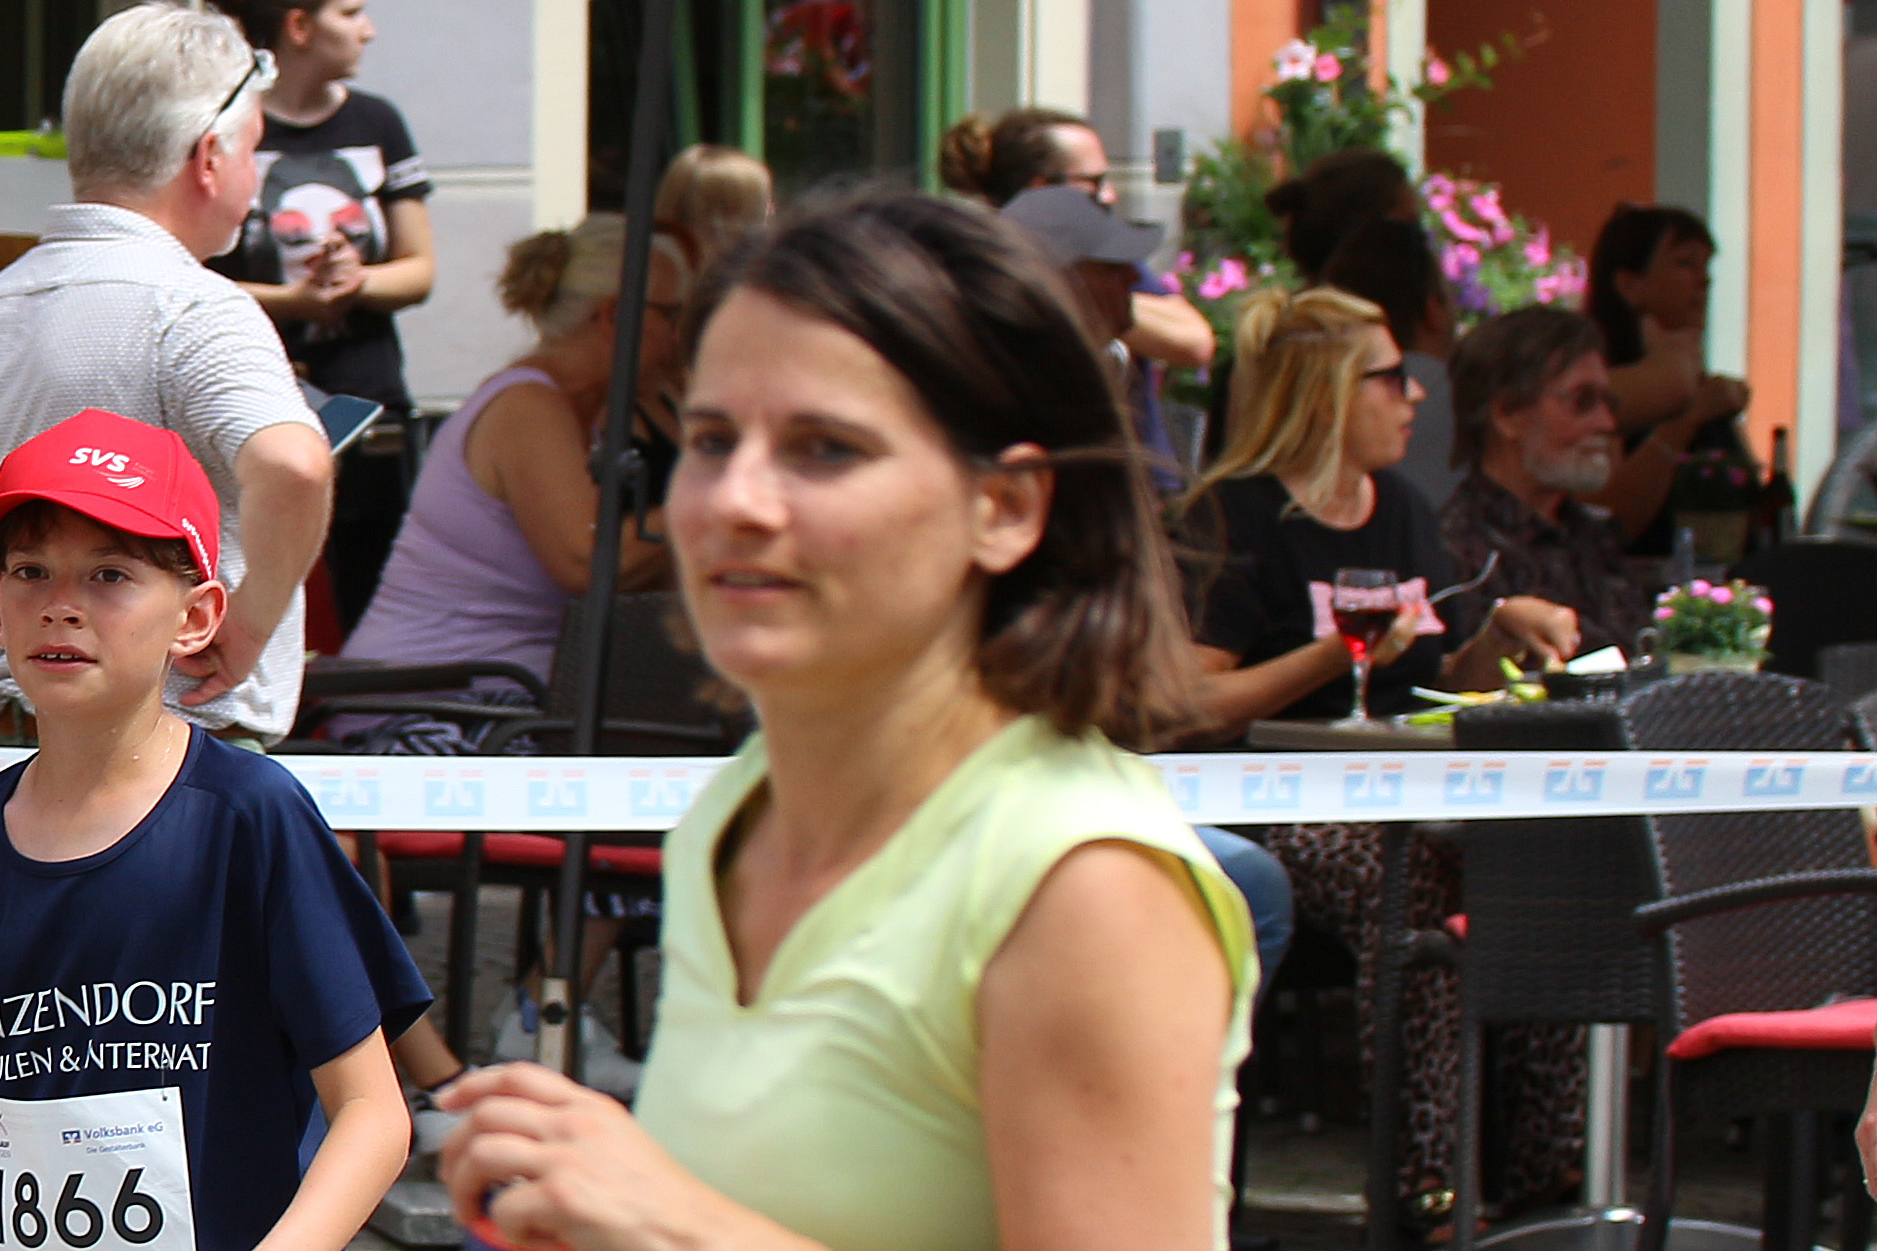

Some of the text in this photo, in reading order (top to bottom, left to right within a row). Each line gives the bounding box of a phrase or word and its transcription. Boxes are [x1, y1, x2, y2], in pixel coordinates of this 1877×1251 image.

[69, 447, 130, 472] SVS
[59, 1045, 82, 1073] &
[84, 1121, 164, 1140] Volksbank eG
